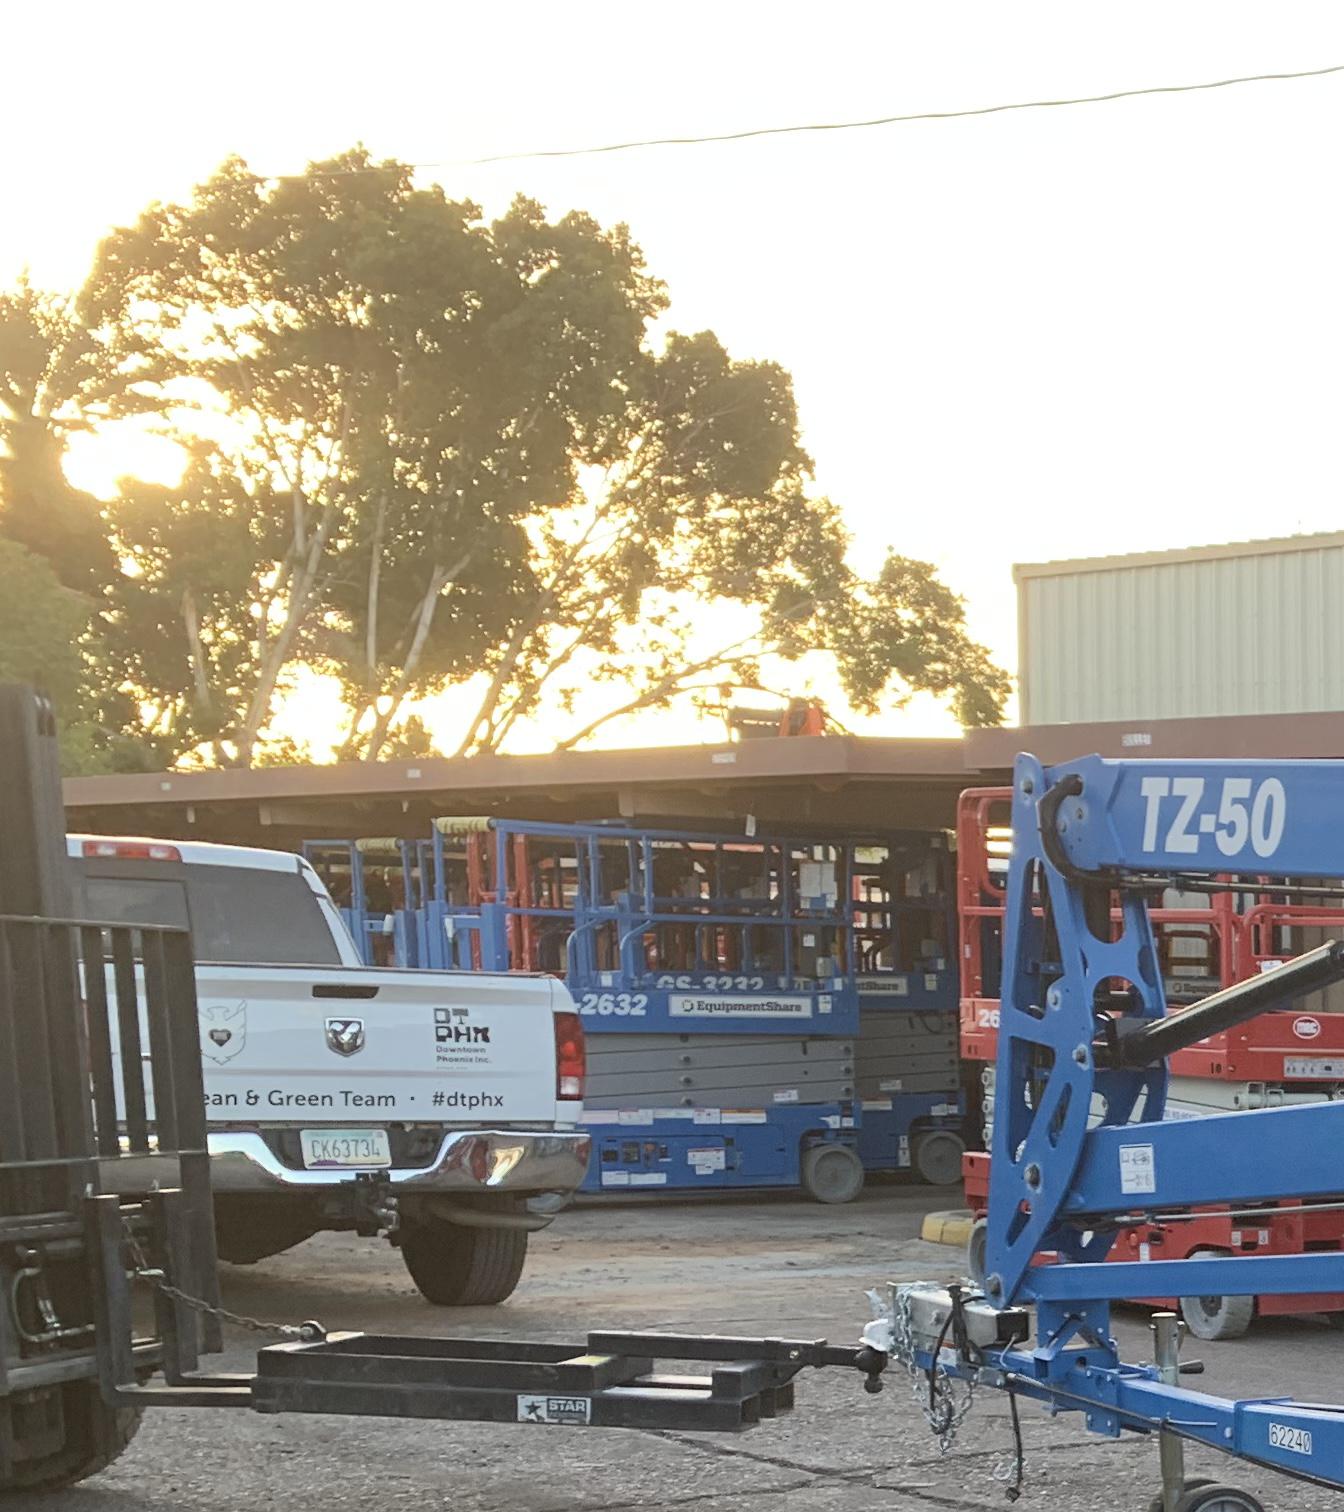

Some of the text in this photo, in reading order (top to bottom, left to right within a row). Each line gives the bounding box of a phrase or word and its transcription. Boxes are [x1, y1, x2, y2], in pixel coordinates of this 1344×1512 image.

[1141, 777, 1286, 858] TZ-50
[696, 1000, 802, 1013] EquipmentShare
[435, 1045, 487, 1054] Downtown
[436, 1055, 474, 1063] Phoenix
[245, 1089, 260, 1106] &
[268, 1089, 333, 1106] Green
[339, 1090, 396, 1107] Team
[432, 1091, 504, 1110] #dtphx
[311, 1139, 381, 1158] CK63734
[548, 1399, 586, 1412] STAR
[1271, 1424, 1311, 1453] 62240
